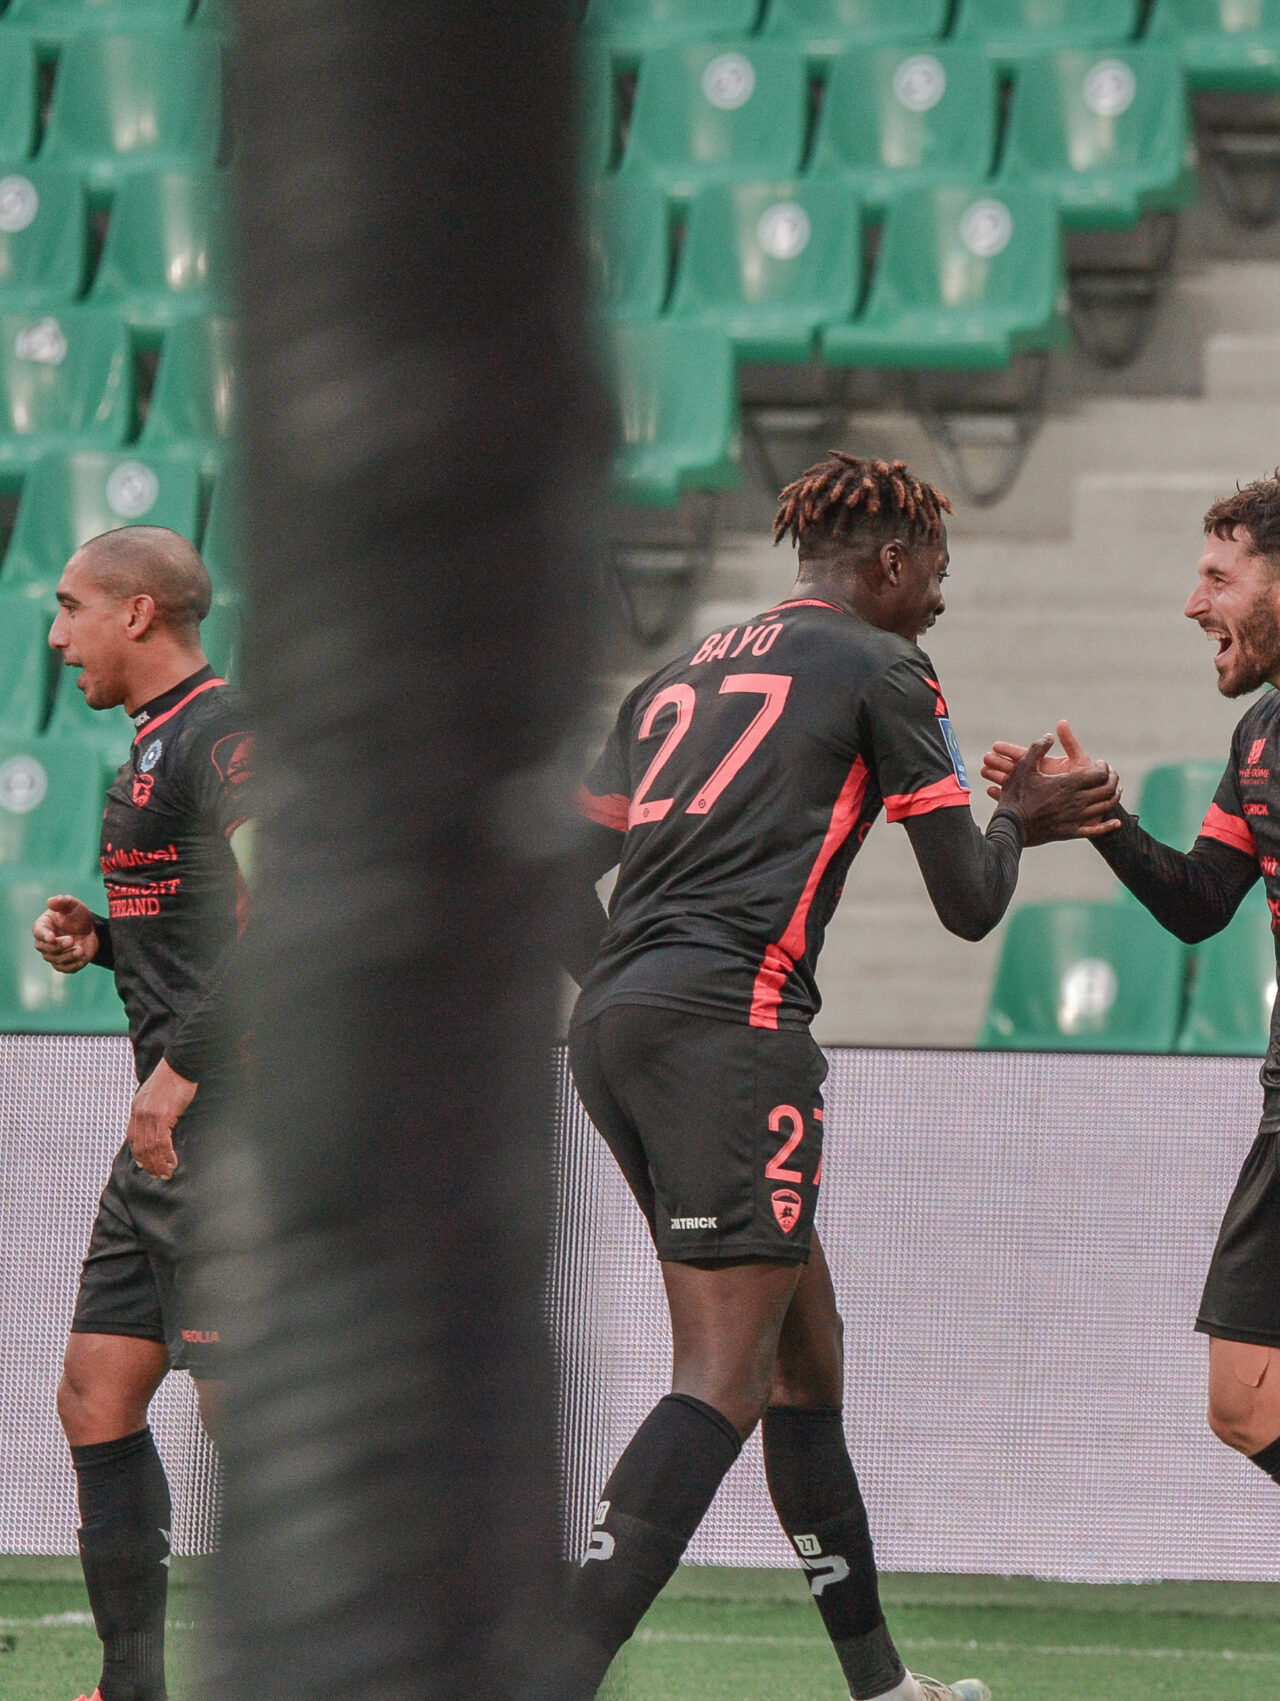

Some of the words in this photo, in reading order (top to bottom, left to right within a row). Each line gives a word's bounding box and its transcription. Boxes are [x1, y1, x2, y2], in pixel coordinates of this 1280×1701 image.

[689, 622, 783, 666] BAYO
[627, 673, 793, 830] 27
[798, 1537, 815, 1552] 27
